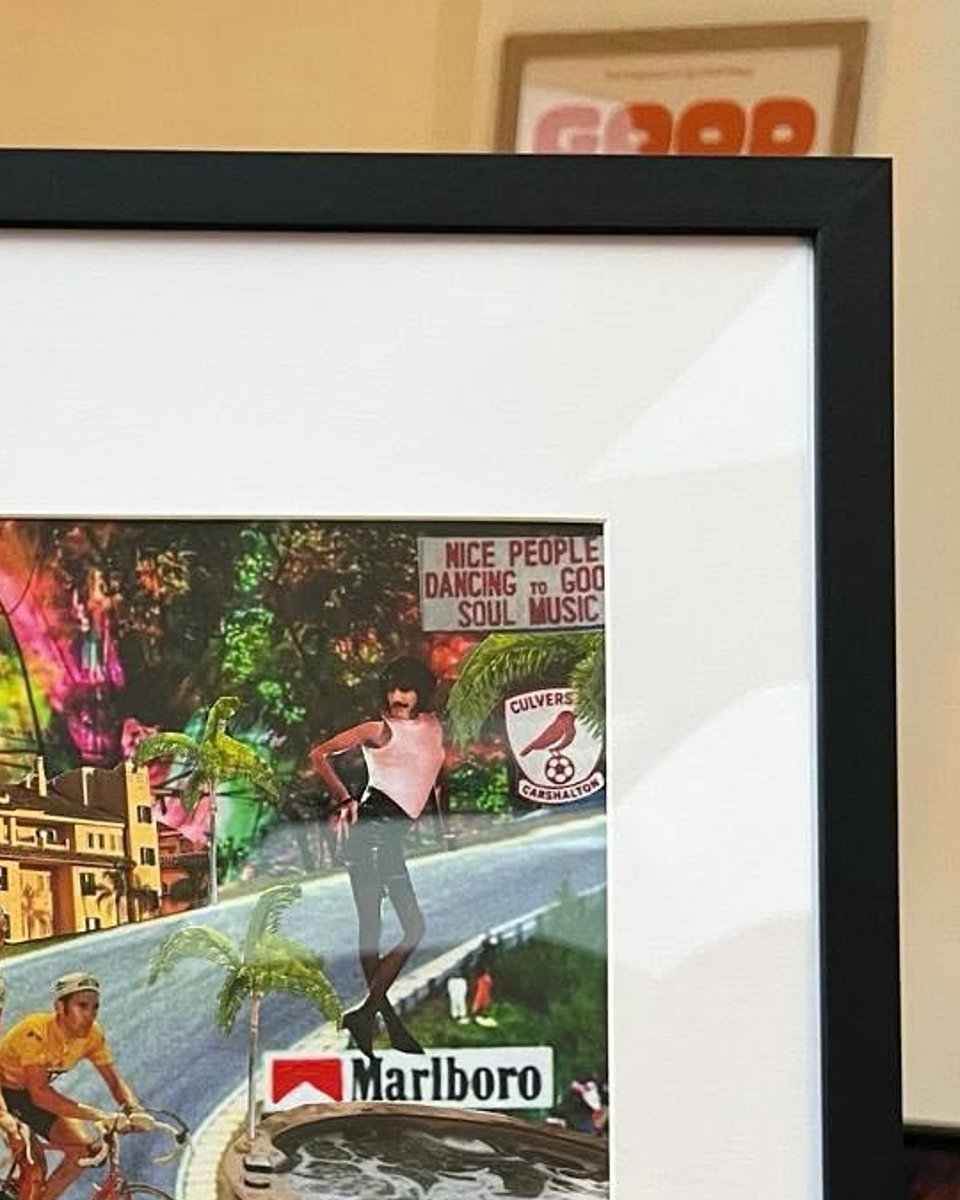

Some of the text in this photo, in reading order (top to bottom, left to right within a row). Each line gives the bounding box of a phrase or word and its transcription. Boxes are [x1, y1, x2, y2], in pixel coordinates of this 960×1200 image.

[445, 538, 599, 568] NICE PEOPLE
[425, 570, 517, 598] DANCING
[529, 582, 548, 595] TO
[457, 595, 599, 627] SOUL MUSIC
[509, 691, 573, 714] CULVERS
[522, 778, 600, 800] CARSHALTON
[351, 1057, 542, 1102] Marlboro
